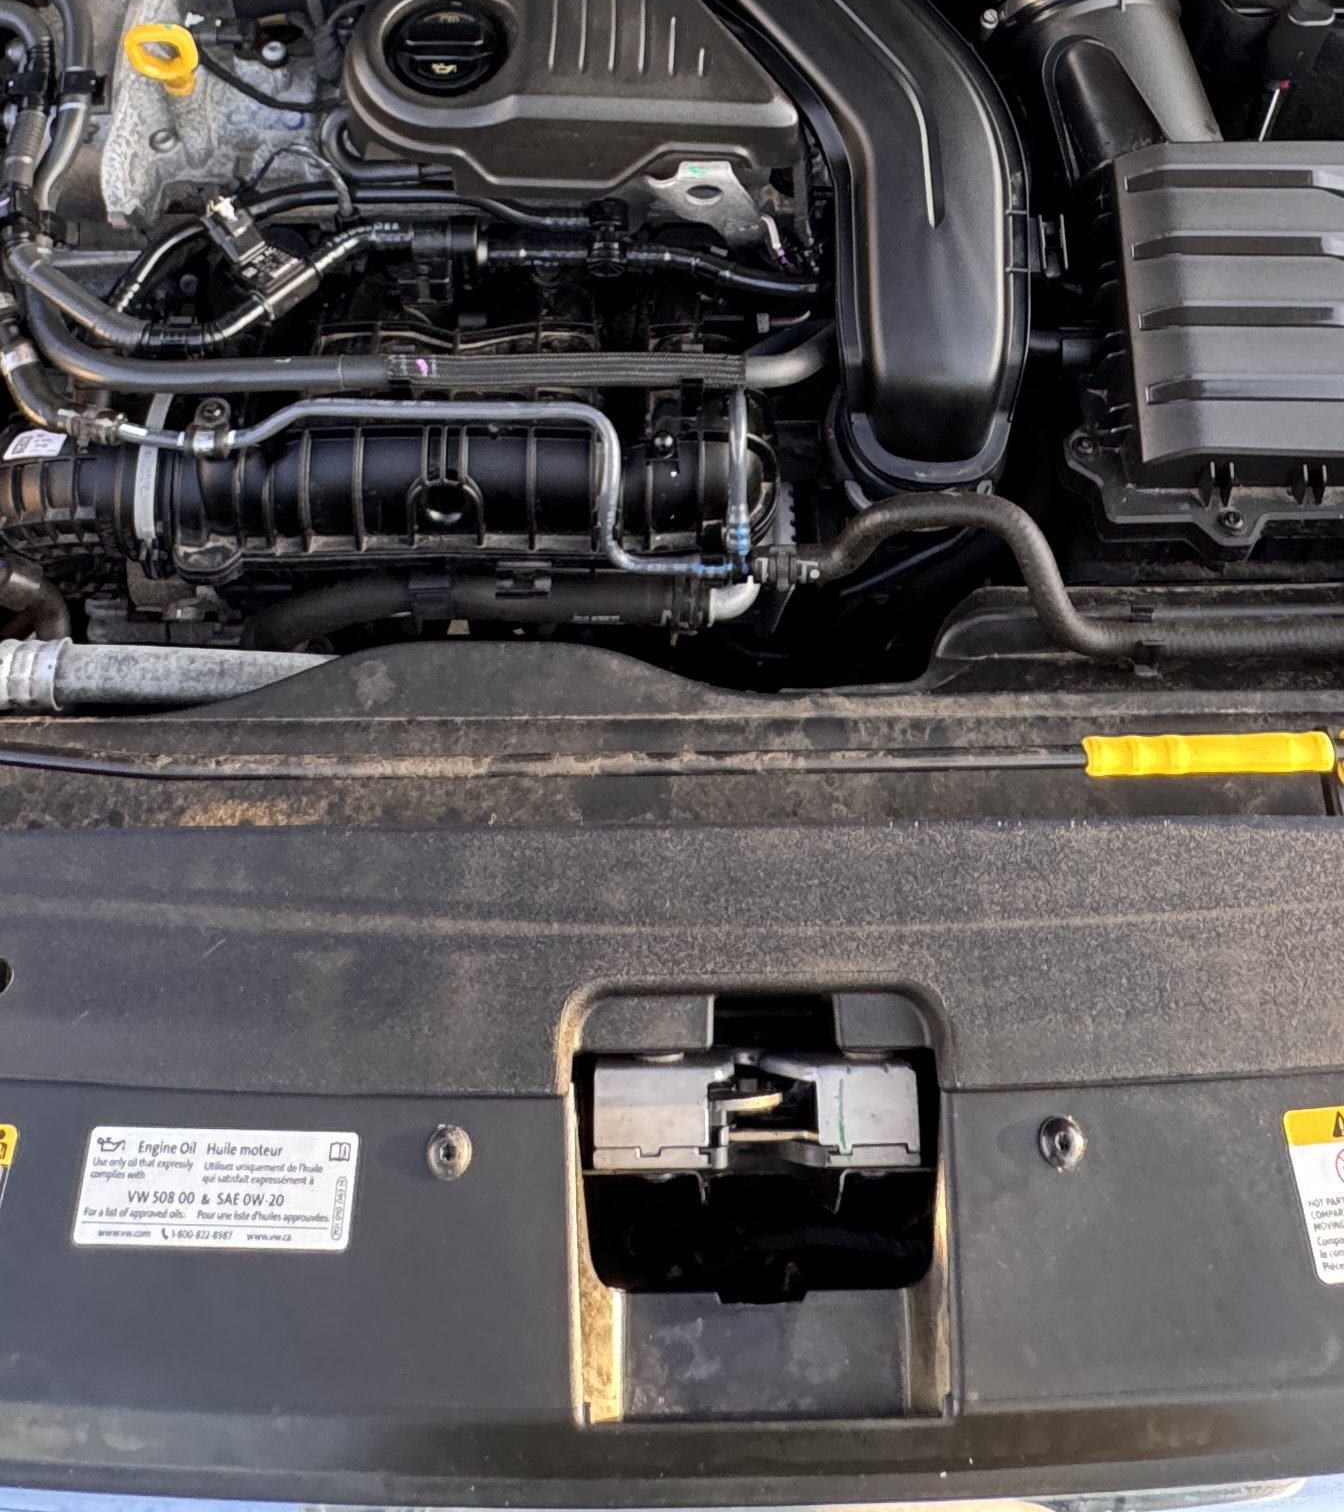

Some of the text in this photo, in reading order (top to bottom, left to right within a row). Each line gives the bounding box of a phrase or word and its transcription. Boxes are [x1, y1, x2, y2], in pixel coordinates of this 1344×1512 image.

[138, 1140, 197, 1157] Engine Oil
[207, 1142, 283, 1157] Huile moteur
[92, 1157, 193, 1172] Use only oil that expressly
[235, 1163, 285, 1174] uniquement
[287, 1163, 297, 1173] de
[90, 1169, 146, 1182] complies with
[202, 1174, 216, 1185] qui
[251, 1175, 307, 1187] expressément
[308, 1175, 316, 1187] à
[128, 1189, 285, 1208] VW 508 00 & SAE 0W-20
[83, 1206, 98, 1217] For
[98, 1208, 105, 1218] a
[105, 1206, 118, 1218] list
[119, 1207, 129, 1218] of
[129, 1208, 168, 1221] approved
[196, 1208, 216, 1220] Pour
[217, 1210, 233, 1221] une
[233, 1209, 250, 1221] liste
[97, 1229, 152, 1239] www.vw.com
[246, 1232, 293, 1242] www.vw.ca
